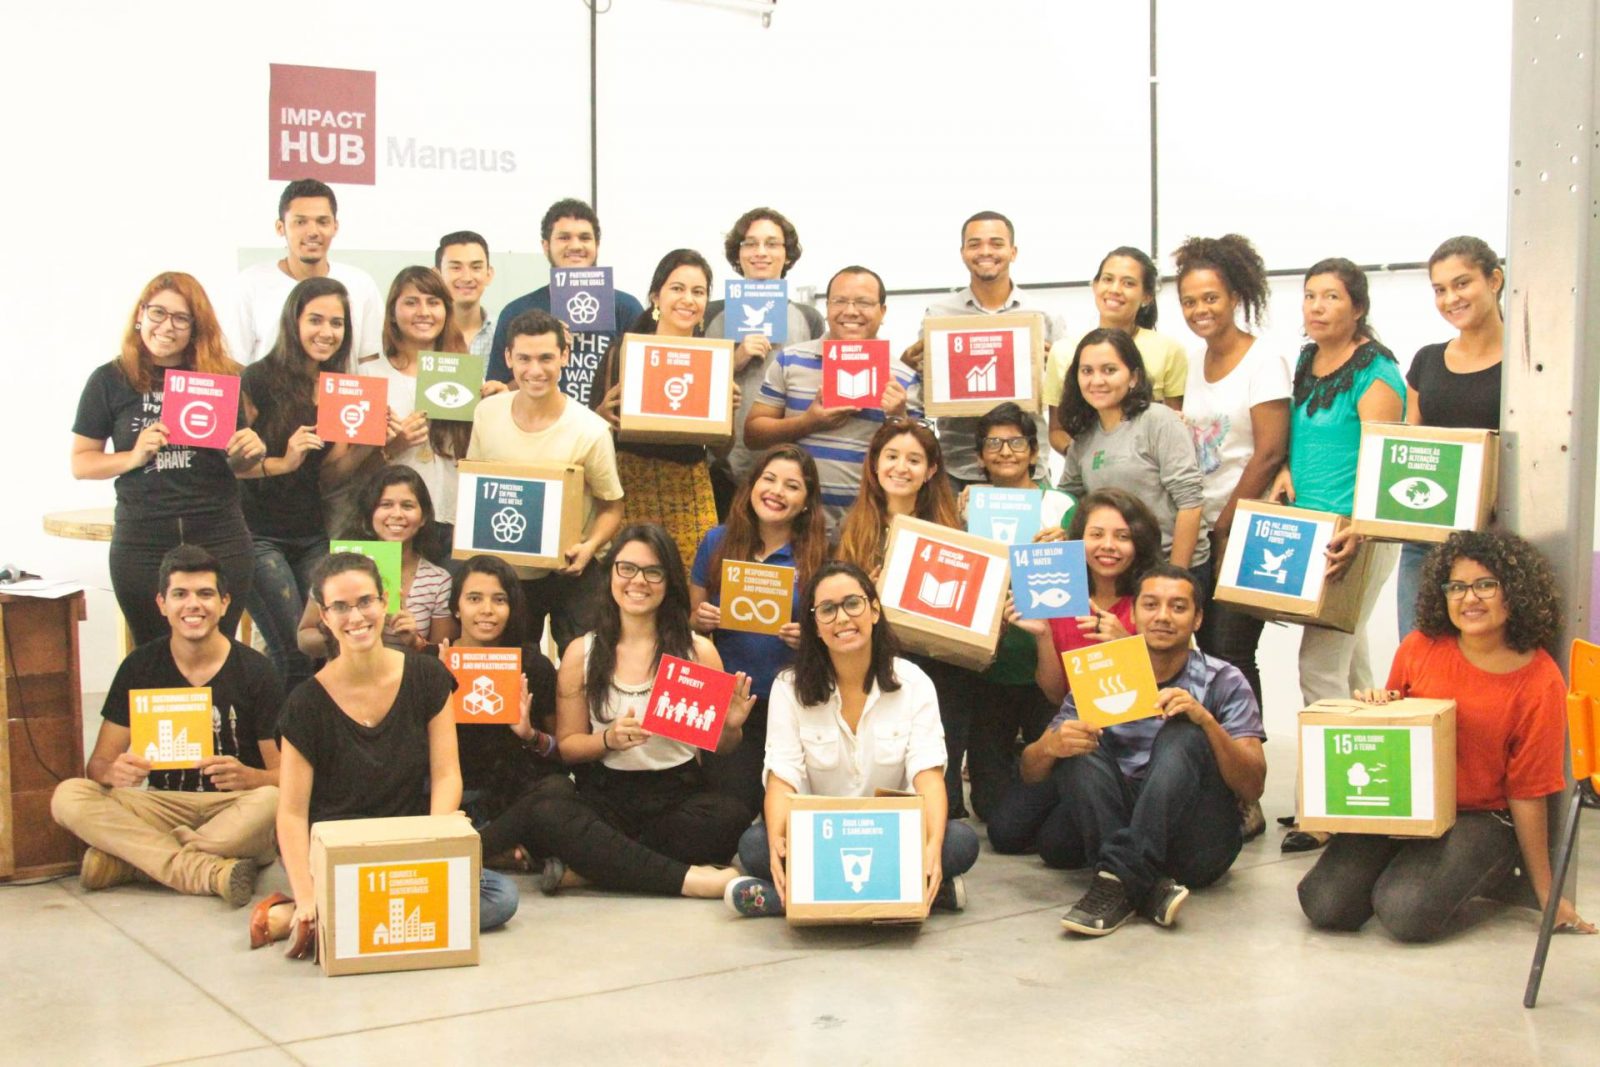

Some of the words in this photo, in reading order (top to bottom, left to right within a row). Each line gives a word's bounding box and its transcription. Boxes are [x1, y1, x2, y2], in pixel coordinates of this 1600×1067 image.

[281, 107, 366, 130] IMPACT
[280, 130, 367, 167] HUB
[386, 136, 518, 174] Manaus
[555, 272, 566, 287] 17
[729, 283, 742, 298] 16
[828, 345, 838, 361] 4
[954, 336, 963, 353] 8
[421, 355, 434, 372] 13
[650, 350, 660, 367] 5
[170, 375, 186, 393] 10
[326, 377, 335, 394] 5
[156, 450, 193, 472] BRAVE
[1391, 444, 1408, 464] 13
[483, 481, 499, 500] 17
[976, 492, 985, 509] 6
[1255, 520, 1271, 538] 16
[921, 544, 932, 562] 4
[1014, 549, 1029, 567] 14
[1032, 549, 1043, 557] LIFE
[1044, 548, 1064, 556] BELOW
[1033, 556, 1053, 566] WATER
[727, 566, 740, 583] 12
[451, 652, 461, 670] 9
[1071, 655, 1084, 675] 2
[667, 662, 676, 680] 1
[681, 666, 691, 676] NO
[678, 674, 705, 690] POVERTY
[135, 695, 149, 714] 11
[1333, 733, 1353, 755] 15
[1353, 735, 1366, 743] VIDA
[822, 818, 833, 839] 6
[368, 871, 387, 893] 11
